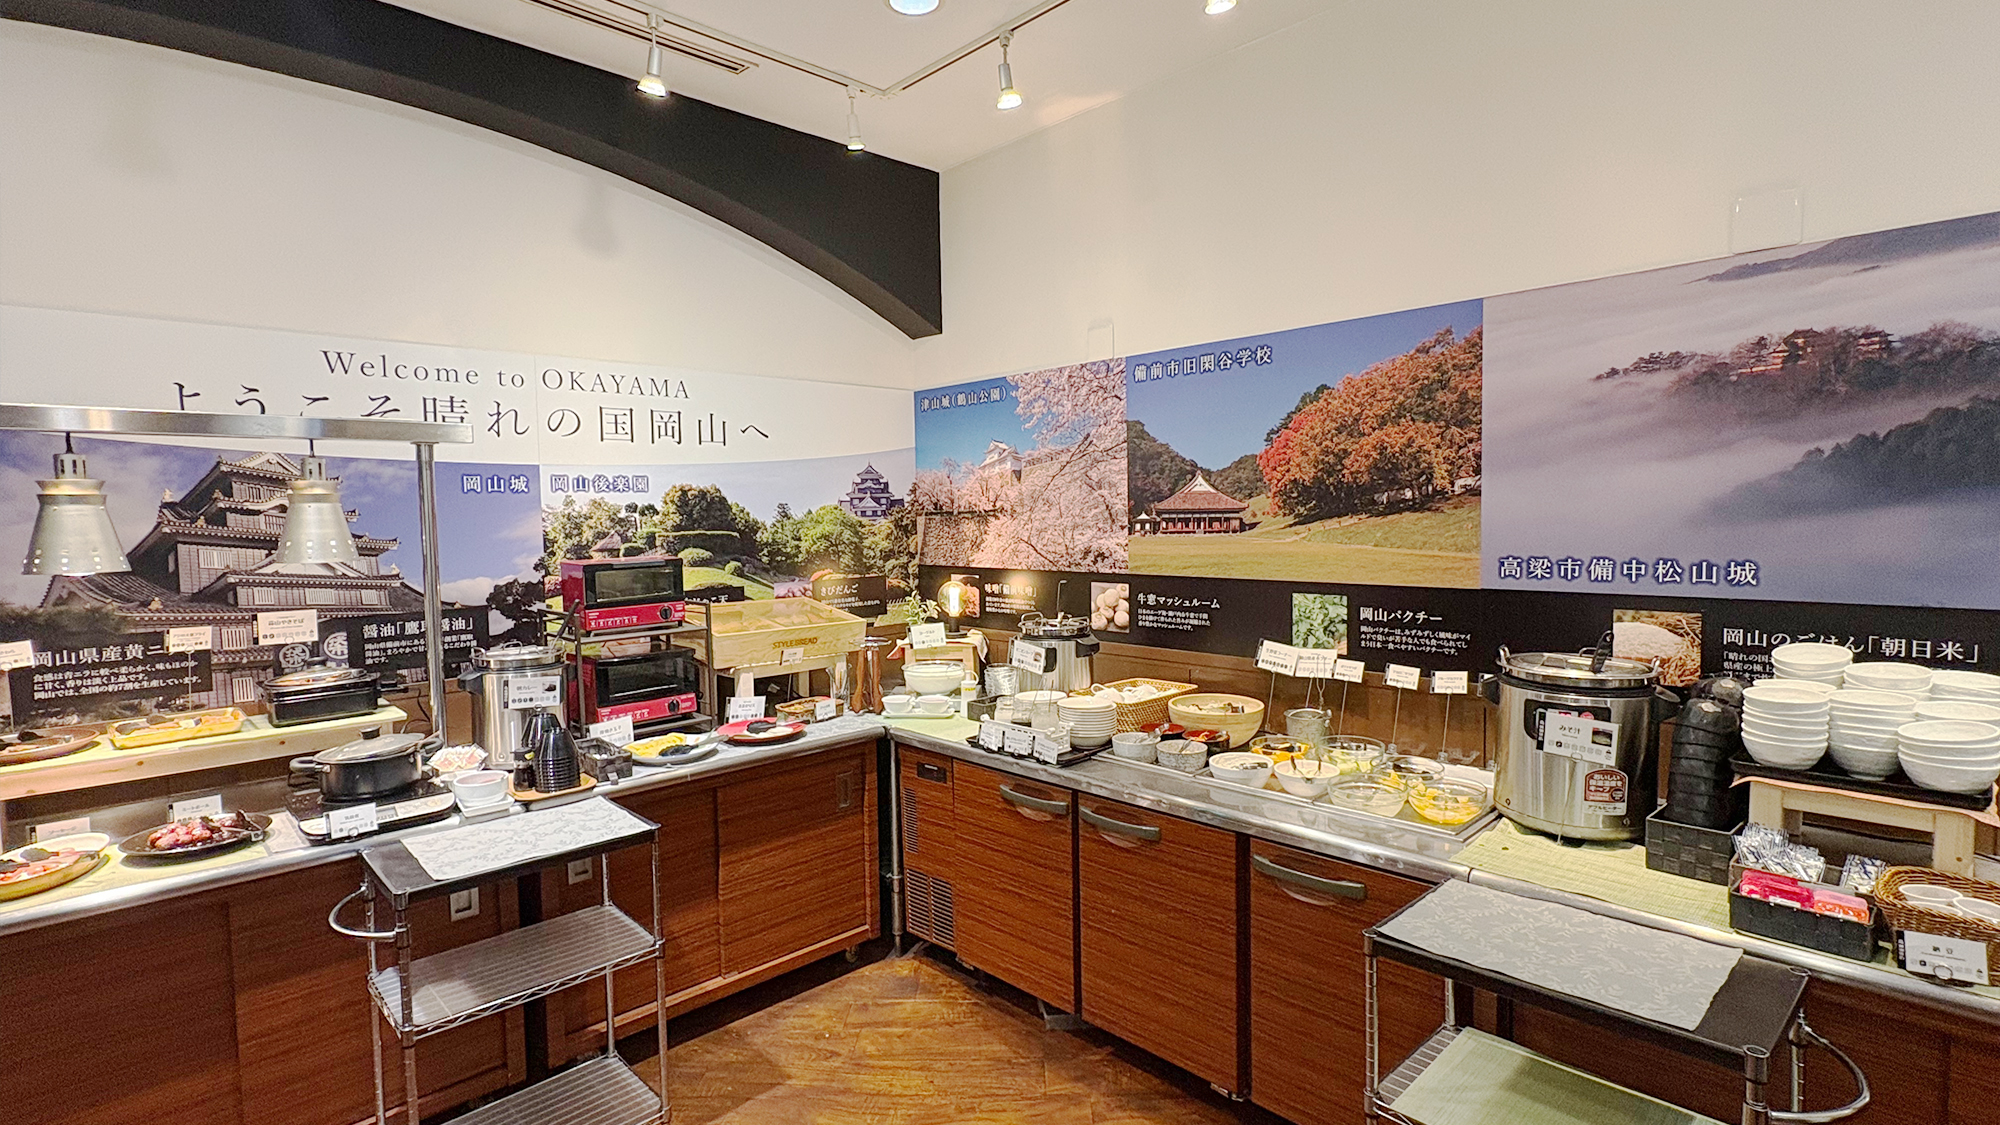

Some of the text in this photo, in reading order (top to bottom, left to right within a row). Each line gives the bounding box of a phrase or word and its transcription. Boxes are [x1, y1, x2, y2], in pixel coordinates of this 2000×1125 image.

[319, 350, 691, 399] Welcome to OKAYAMA
[1133, 346, 1272, 383] 備前市旧閑谷学校
[462, 474, 530, 494] 岡山城
[550, 474, 649, 494] 岡山後楽園
[1498, 556, 1758, 586] 高梁市備中松山城
[820, 583, 859, 597] きびだんご
[1360, 606, 1443, 625] 岡山パクチー
[32, 643, 176, 669] 岡山県産黄ニ
[1559, 724, 1581, 735] みそ汁
